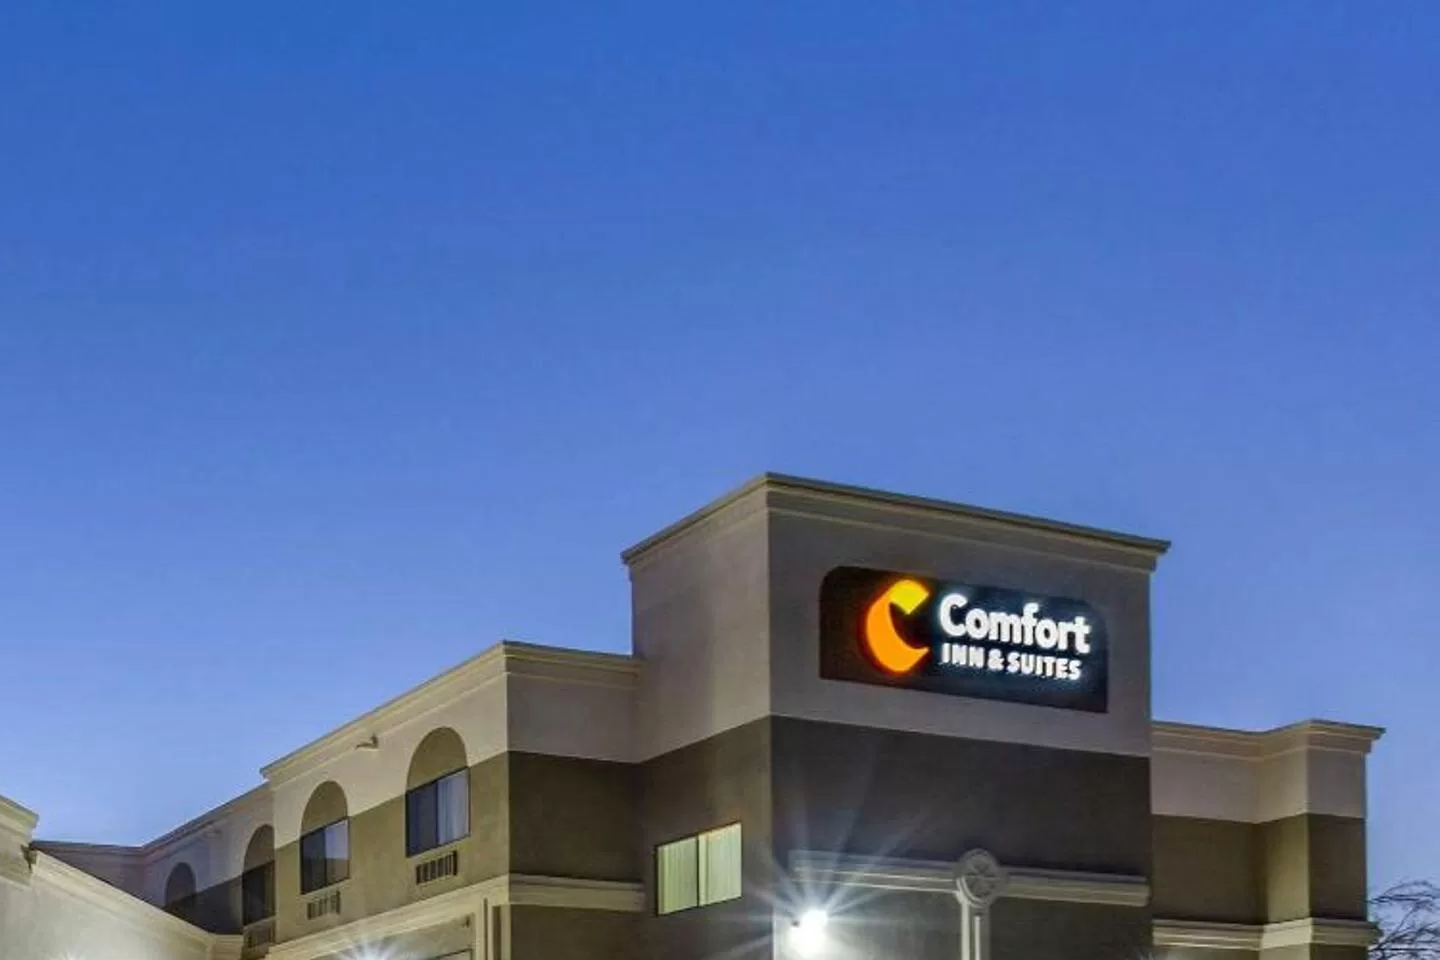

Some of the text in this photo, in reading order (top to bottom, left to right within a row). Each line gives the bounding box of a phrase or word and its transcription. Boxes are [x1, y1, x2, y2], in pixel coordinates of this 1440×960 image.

[940, 593, 1091, 653] Comfort
[942, 643, 1081, 680] INN & SUITES
